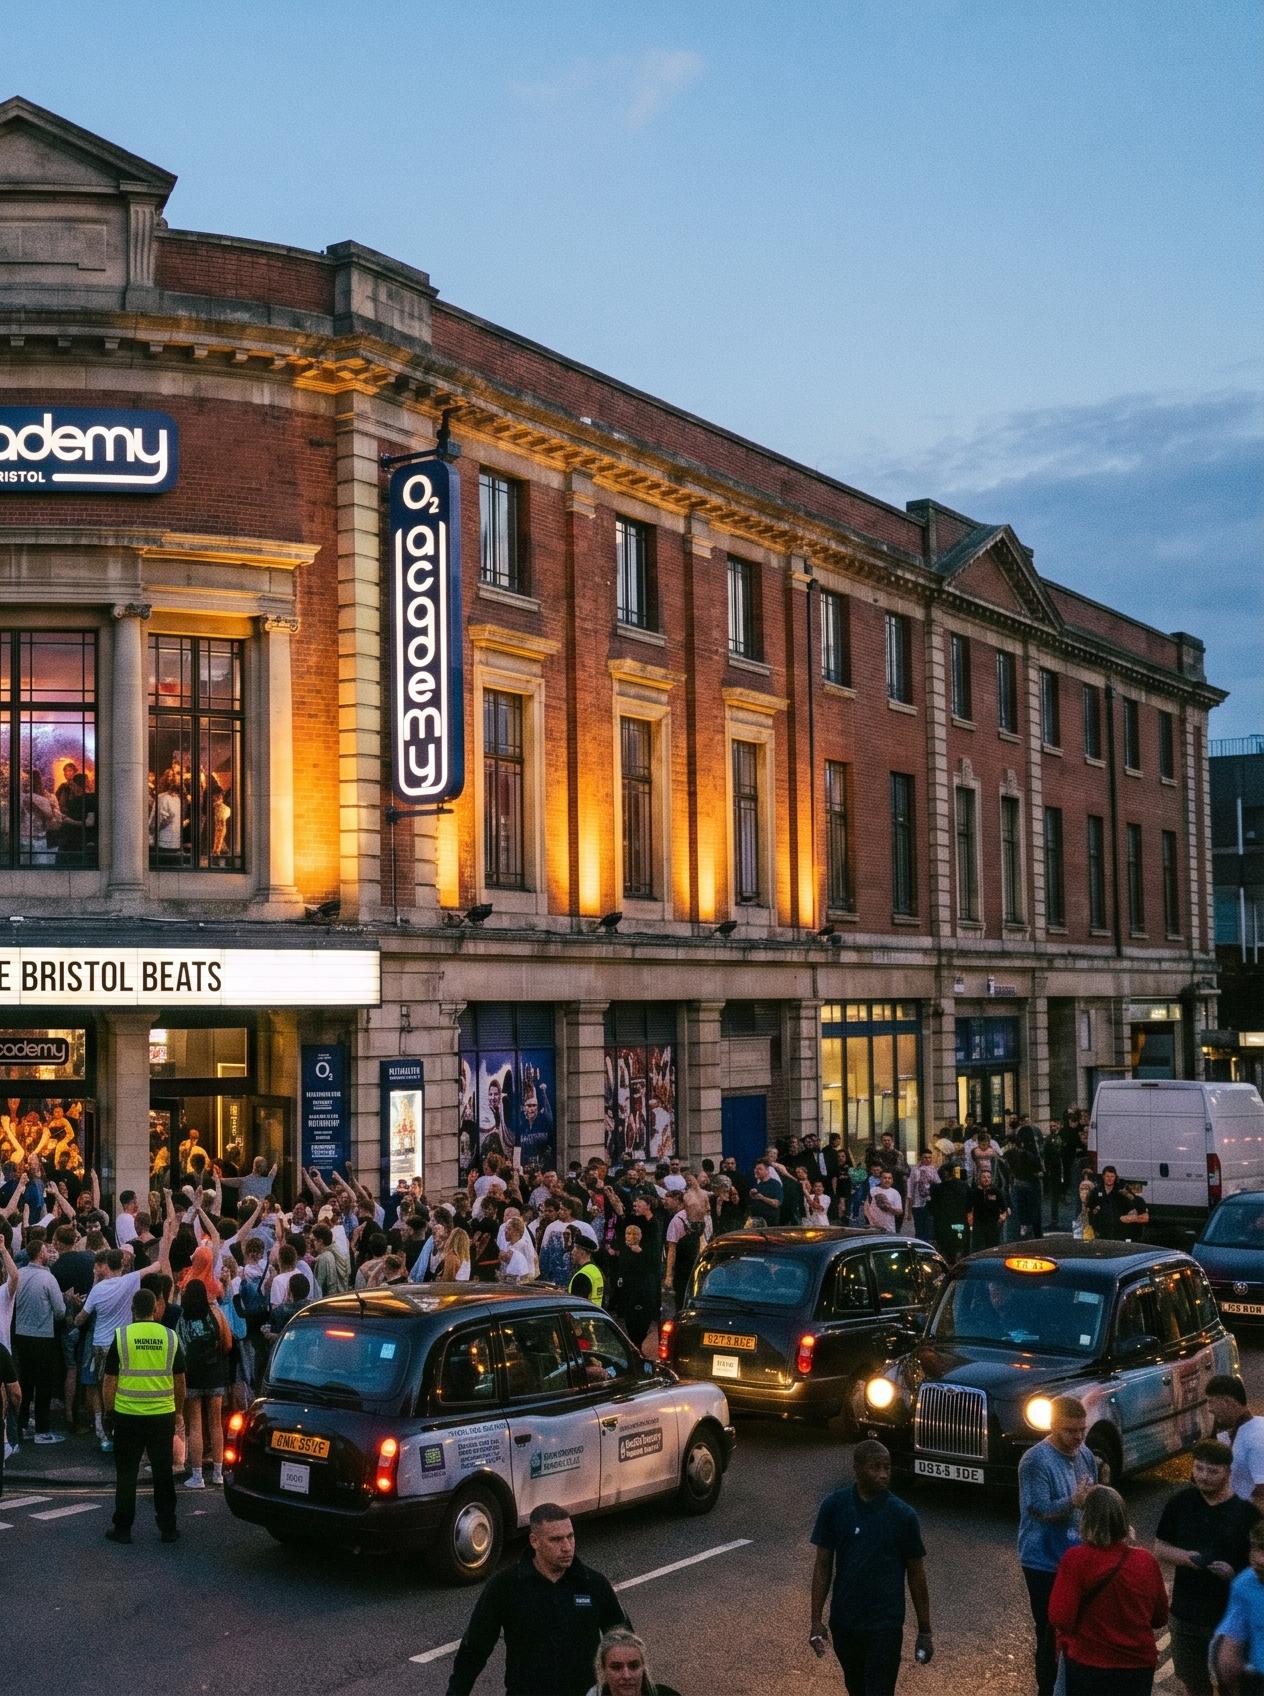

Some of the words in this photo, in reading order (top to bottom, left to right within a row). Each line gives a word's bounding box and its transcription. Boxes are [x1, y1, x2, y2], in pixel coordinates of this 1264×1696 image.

[403, 525, 442, 788] academy
[23, 960, 134, 992] BRISTOL
[142, 961, 222, 992] BEATS
